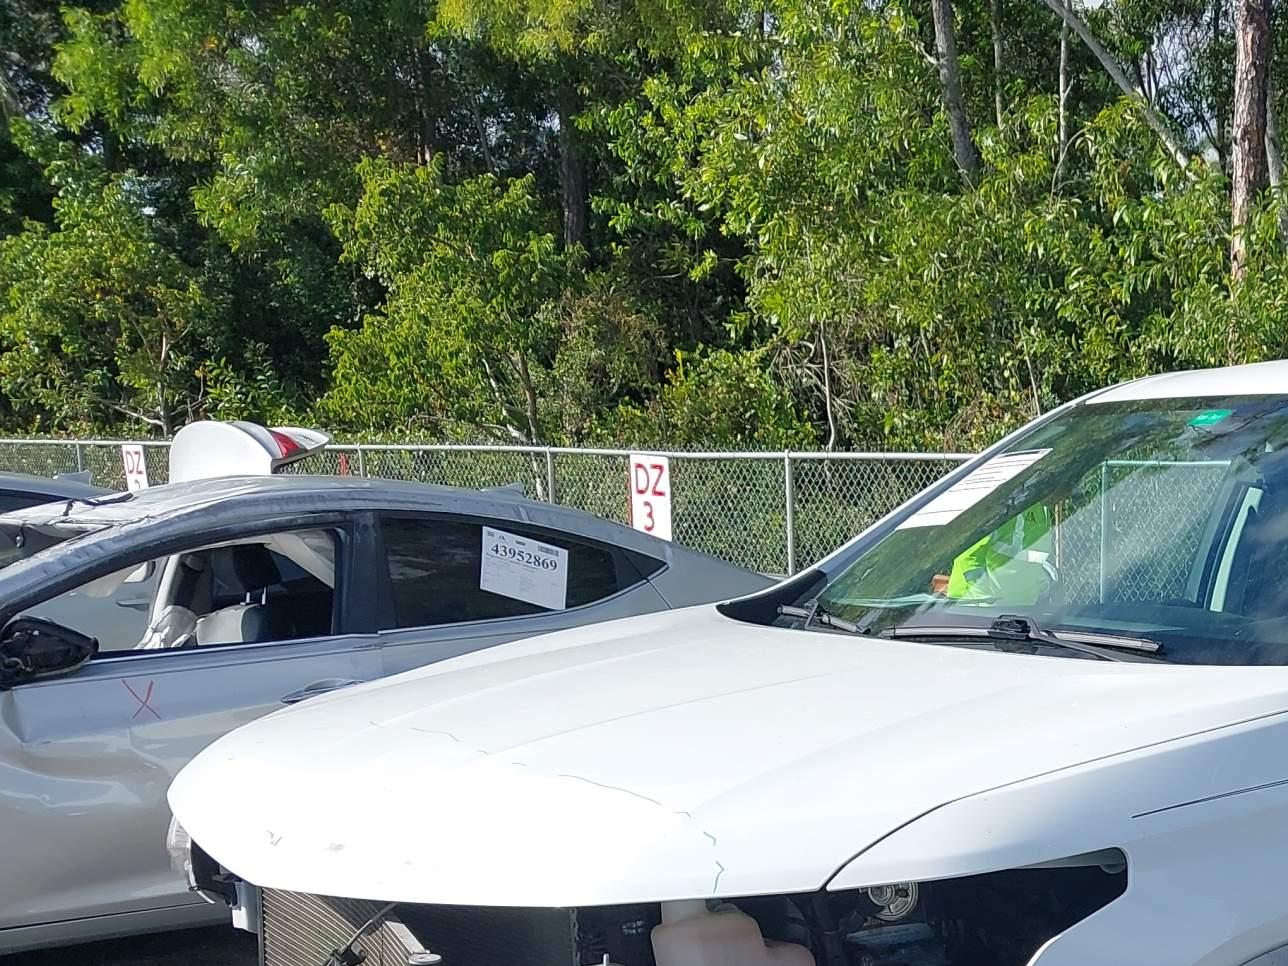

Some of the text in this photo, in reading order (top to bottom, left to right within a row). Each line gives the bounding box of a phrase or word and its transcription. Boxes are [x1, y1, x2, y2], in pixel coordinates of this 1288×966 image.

[125, 450, 144, 475] DZ
[634, 463, 666, 497] DZ
[643, 501, 655, 532] 3
[491, 543, 558, 571] 43952869
